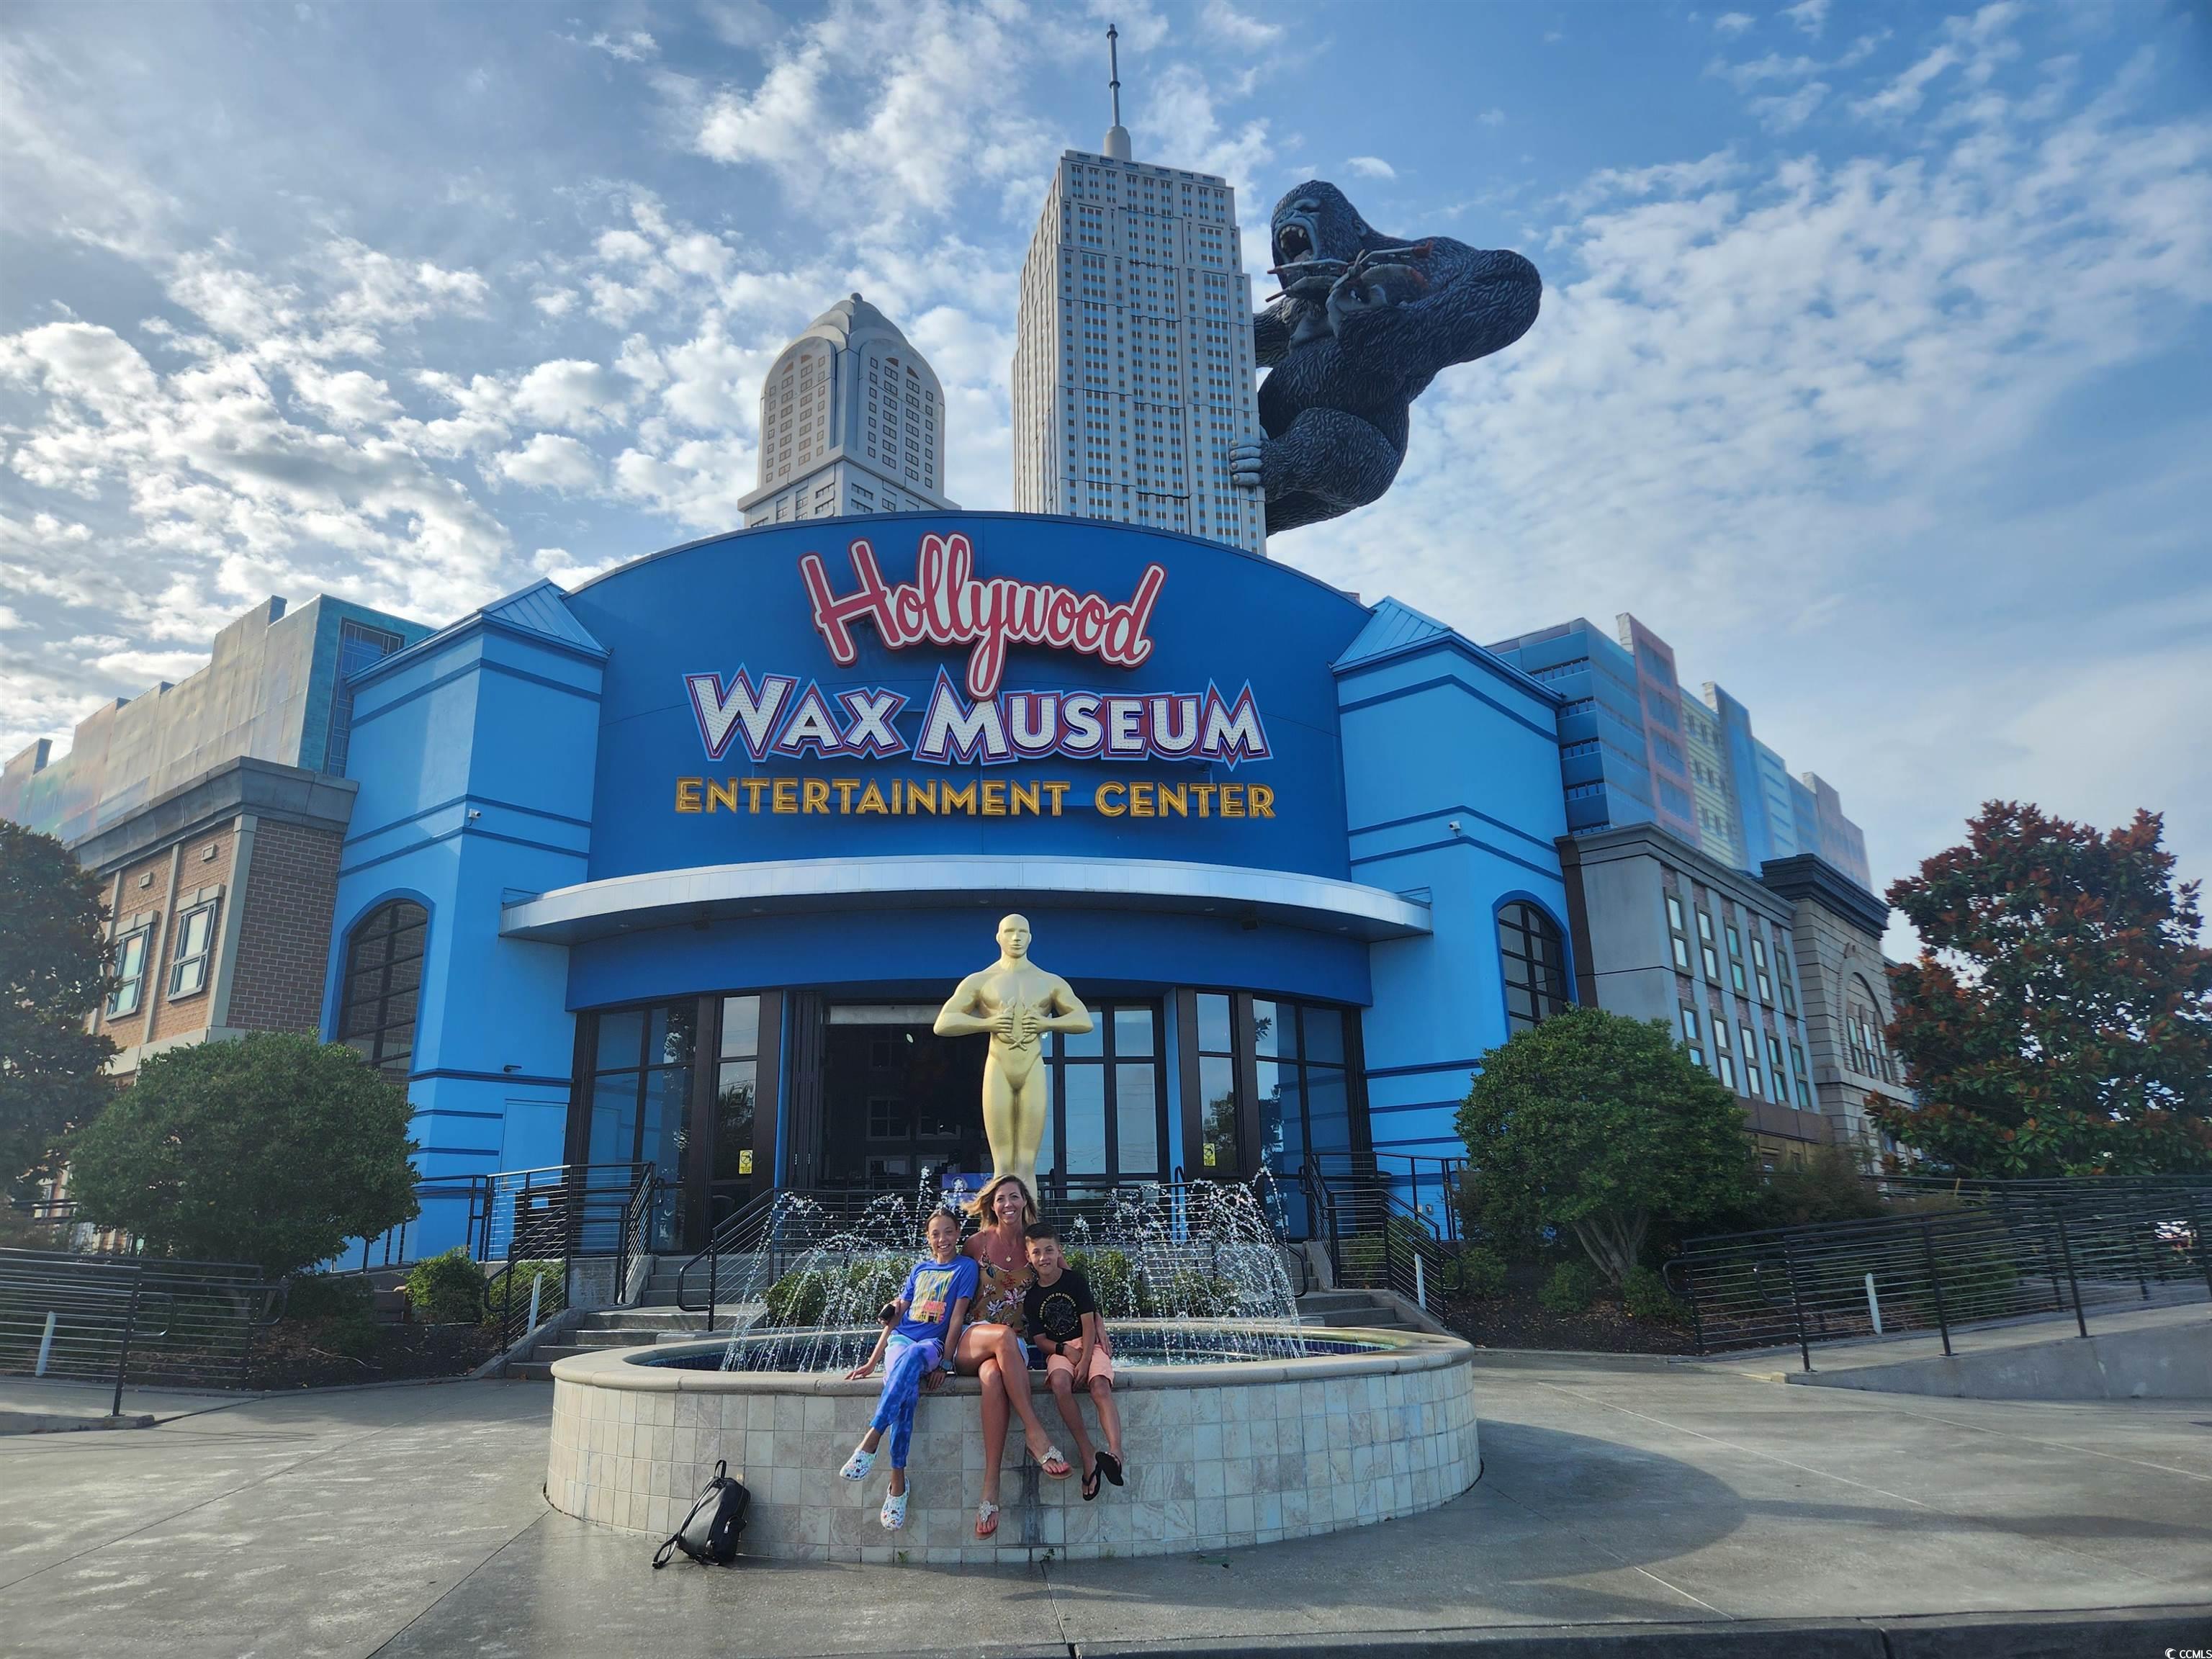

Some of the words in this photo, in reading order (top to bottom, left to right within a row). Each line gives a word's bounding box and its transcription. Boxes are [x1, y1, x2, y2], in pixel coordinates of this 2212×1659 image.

[798, 531, 1168, 700] Hollywood
[683, 665, 909, 761] WAX
[912, 665, 1272, 769] MUSEUM
[675, 776, 1071, 817] ENTERTAINMENT
[1094, 781, 1277, 819] CENTER
